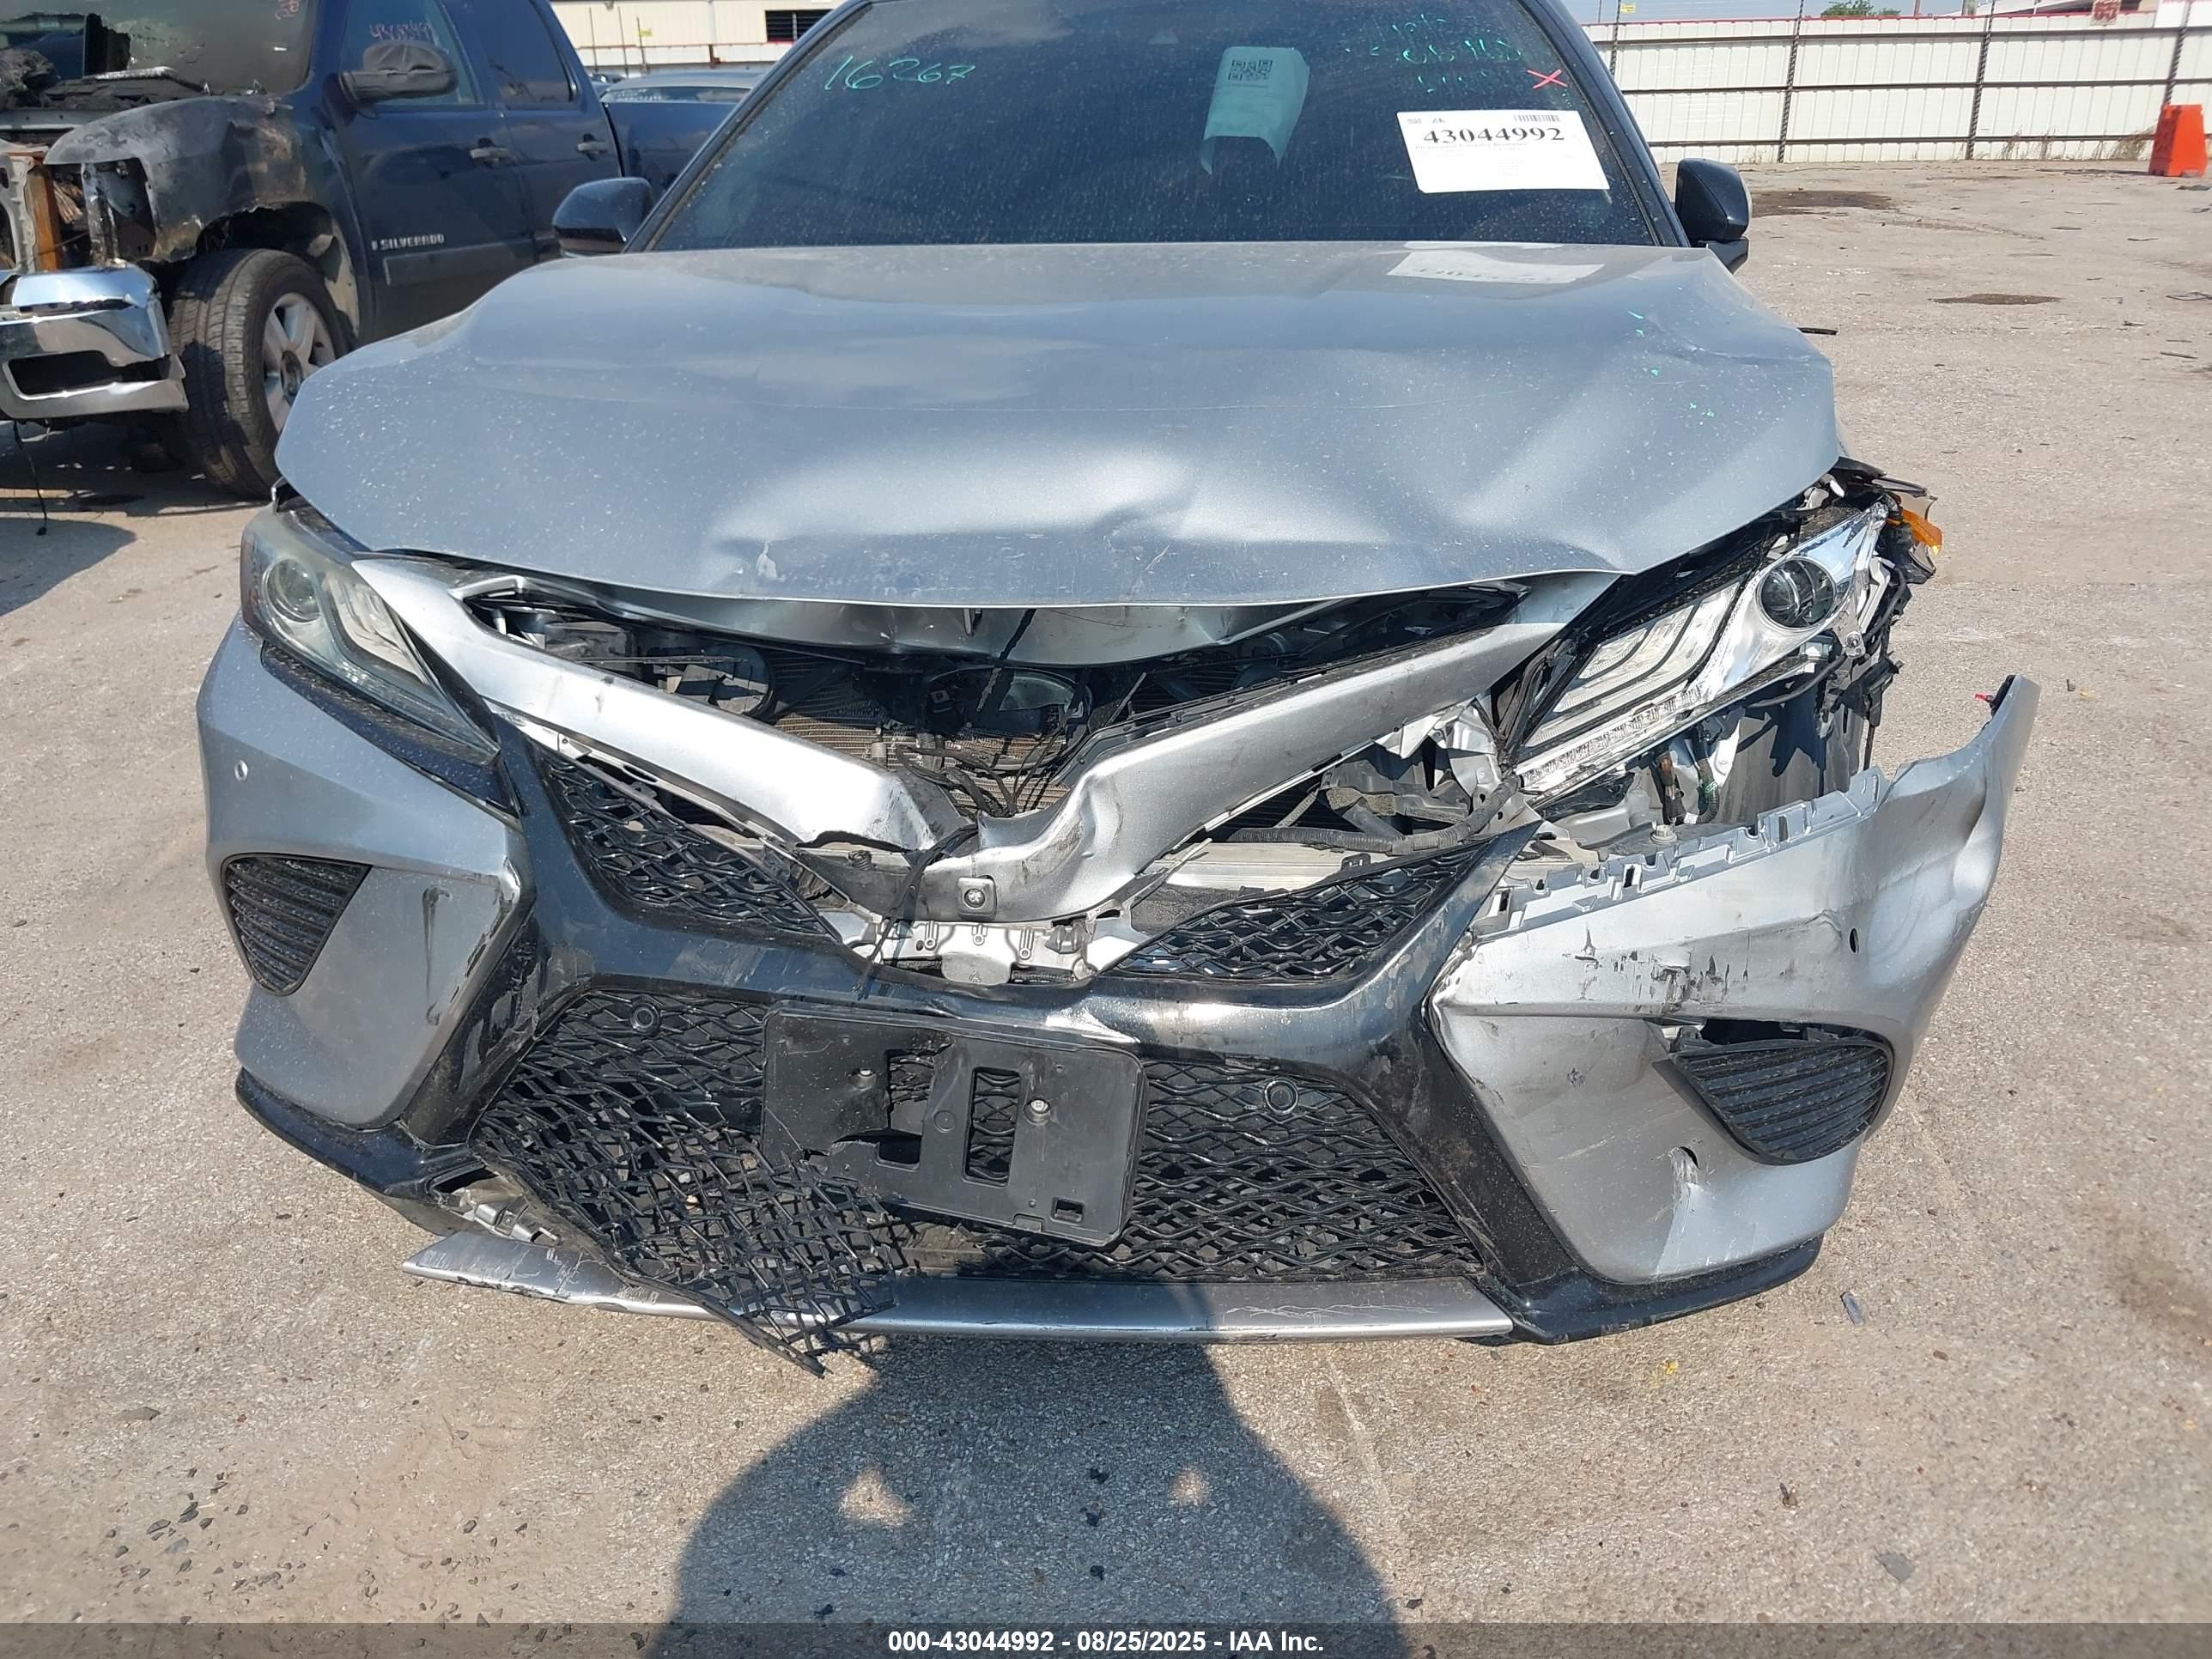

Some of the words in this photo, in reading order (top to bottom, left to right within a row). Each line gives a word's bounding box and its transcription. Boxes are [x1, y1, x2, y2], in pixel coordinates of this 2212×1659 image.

[824, 55, 976, 90] 16267
[1423, 126, 1565, 144] 43044992
[380, 234, 445, 251] SILVERADO
